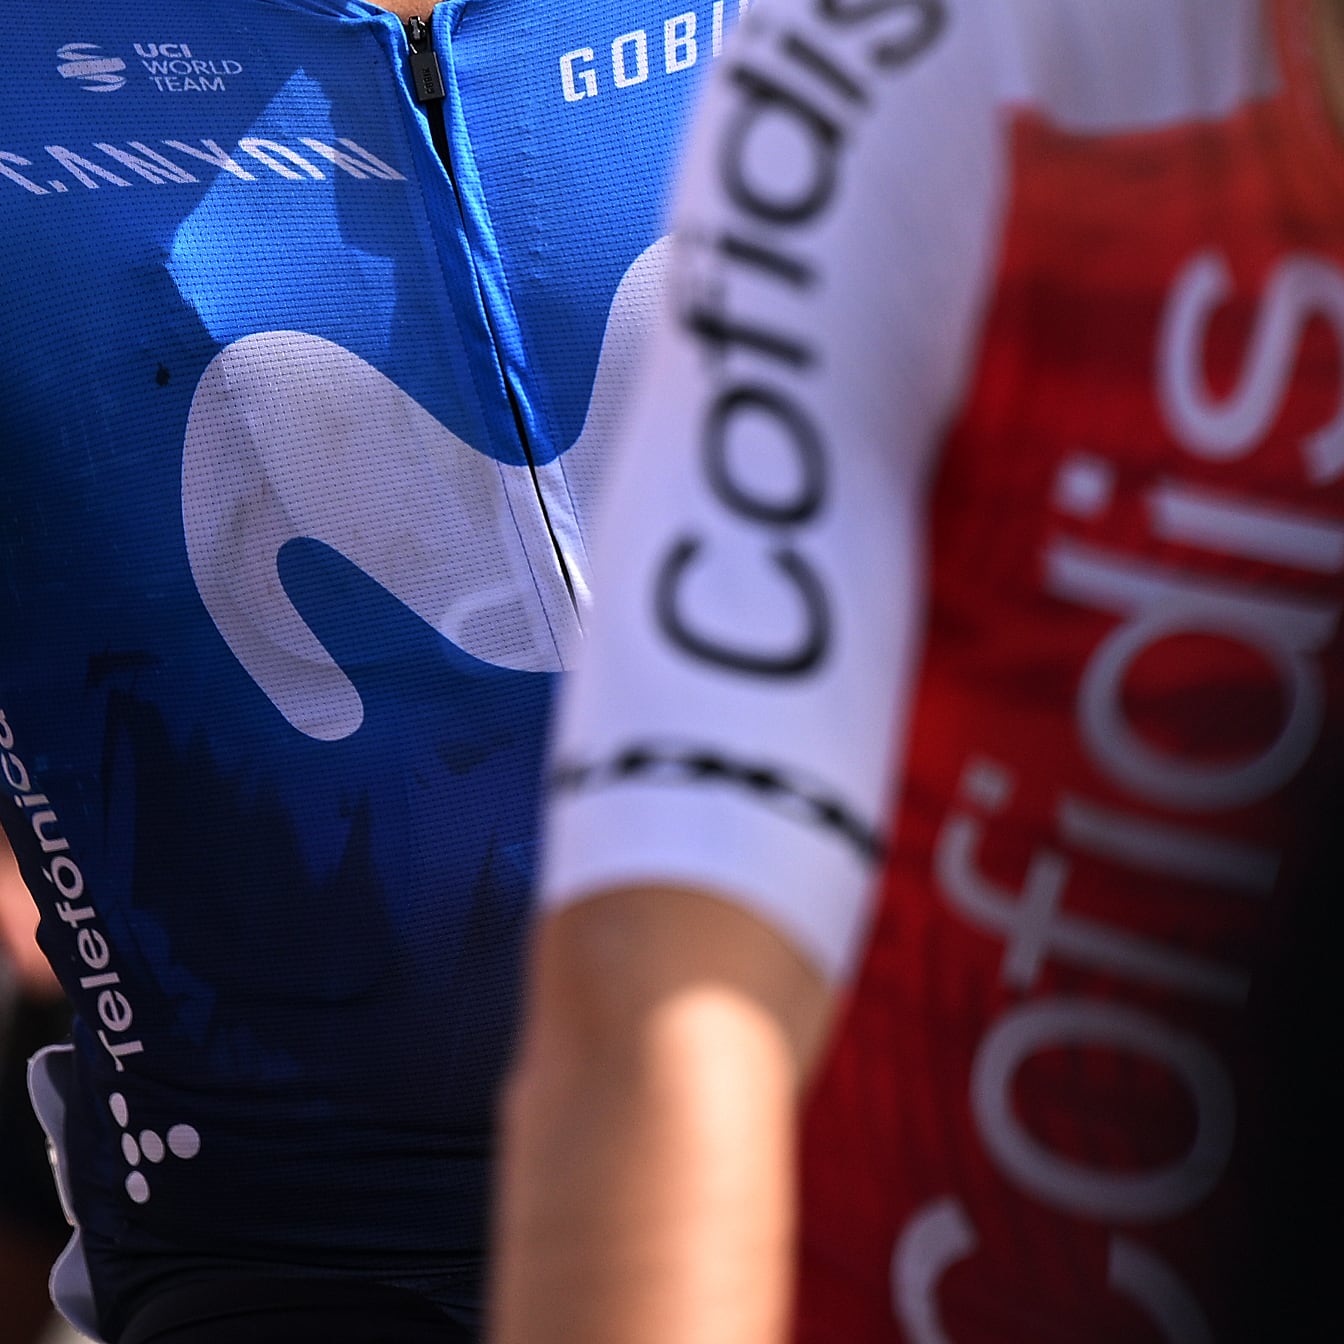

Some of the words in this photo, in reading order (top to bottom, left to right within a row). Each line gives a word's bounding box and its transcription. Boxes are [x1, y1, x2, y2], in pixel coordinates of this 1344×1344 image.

[133, 43, 193, 58] UCI
[142, 59, 243, 75] WORLD
[149, 76, 226, 92] TEAM
